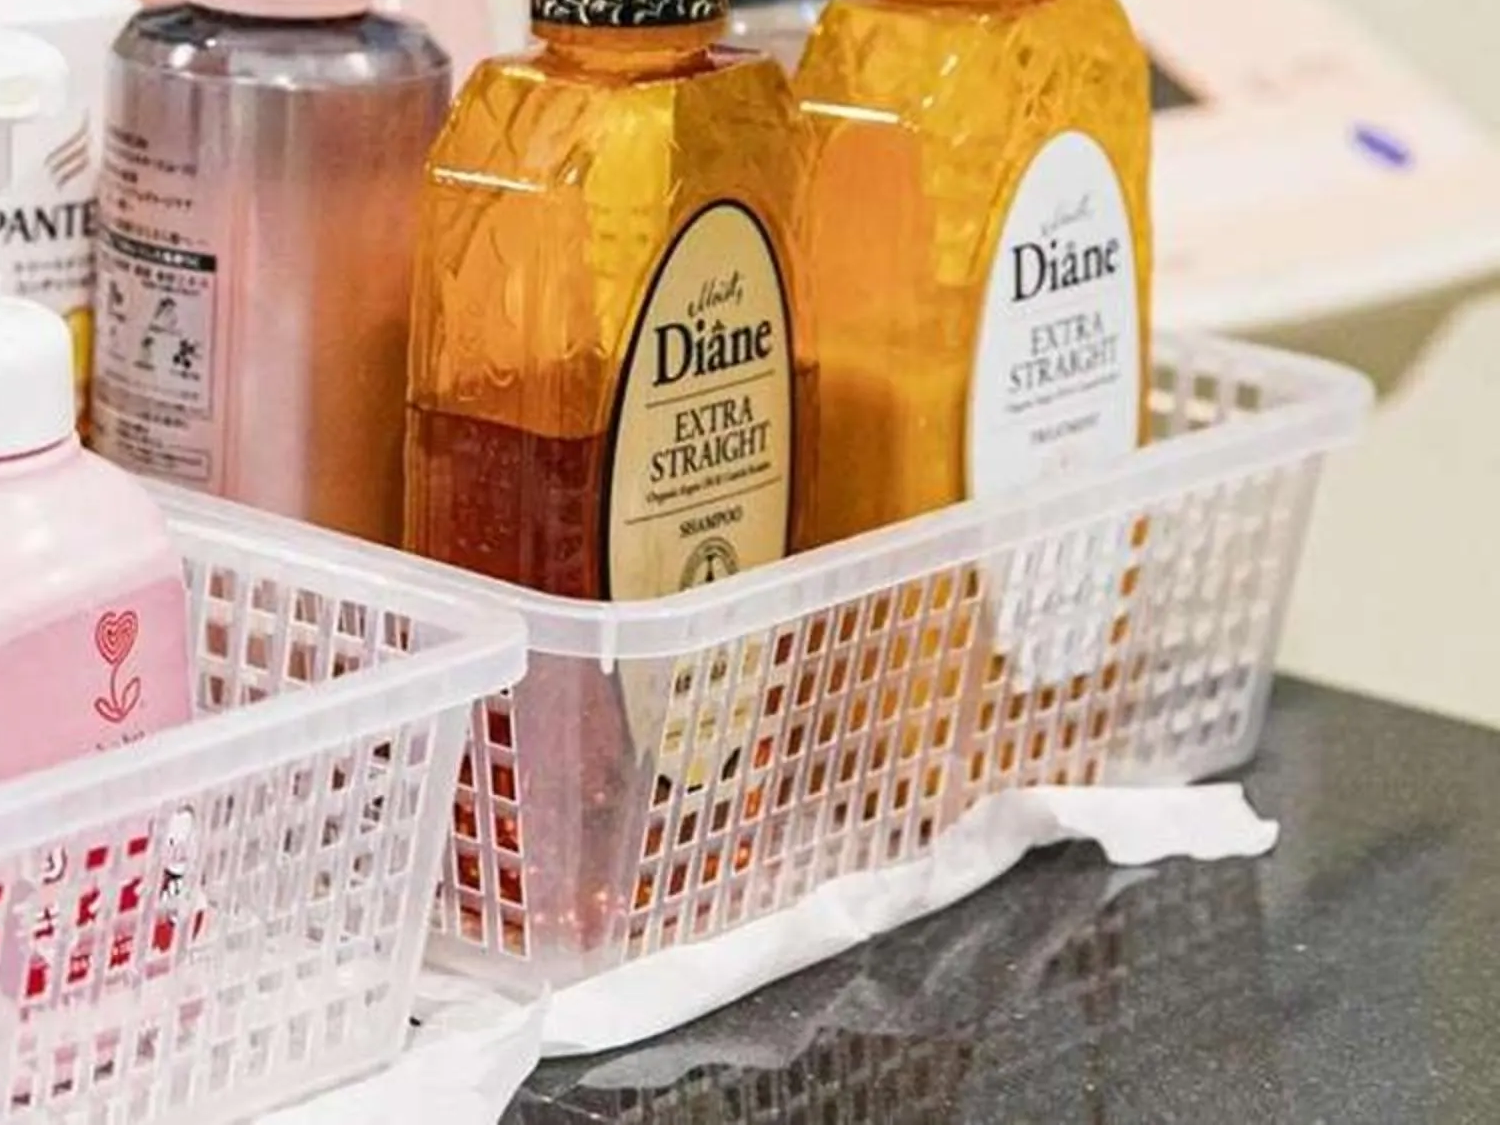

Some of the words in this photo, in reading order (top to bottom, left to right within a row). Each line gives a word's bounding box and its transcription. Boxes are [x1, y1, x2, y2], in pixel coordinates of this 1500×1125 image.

[1030, 311, 1105, 356] EXTRA
[1007, 334, 1119, 394] STRAIGHT
[674, 395, 754, 443] EXTRA
[650, 420, 771, 483] STRAIGHT
